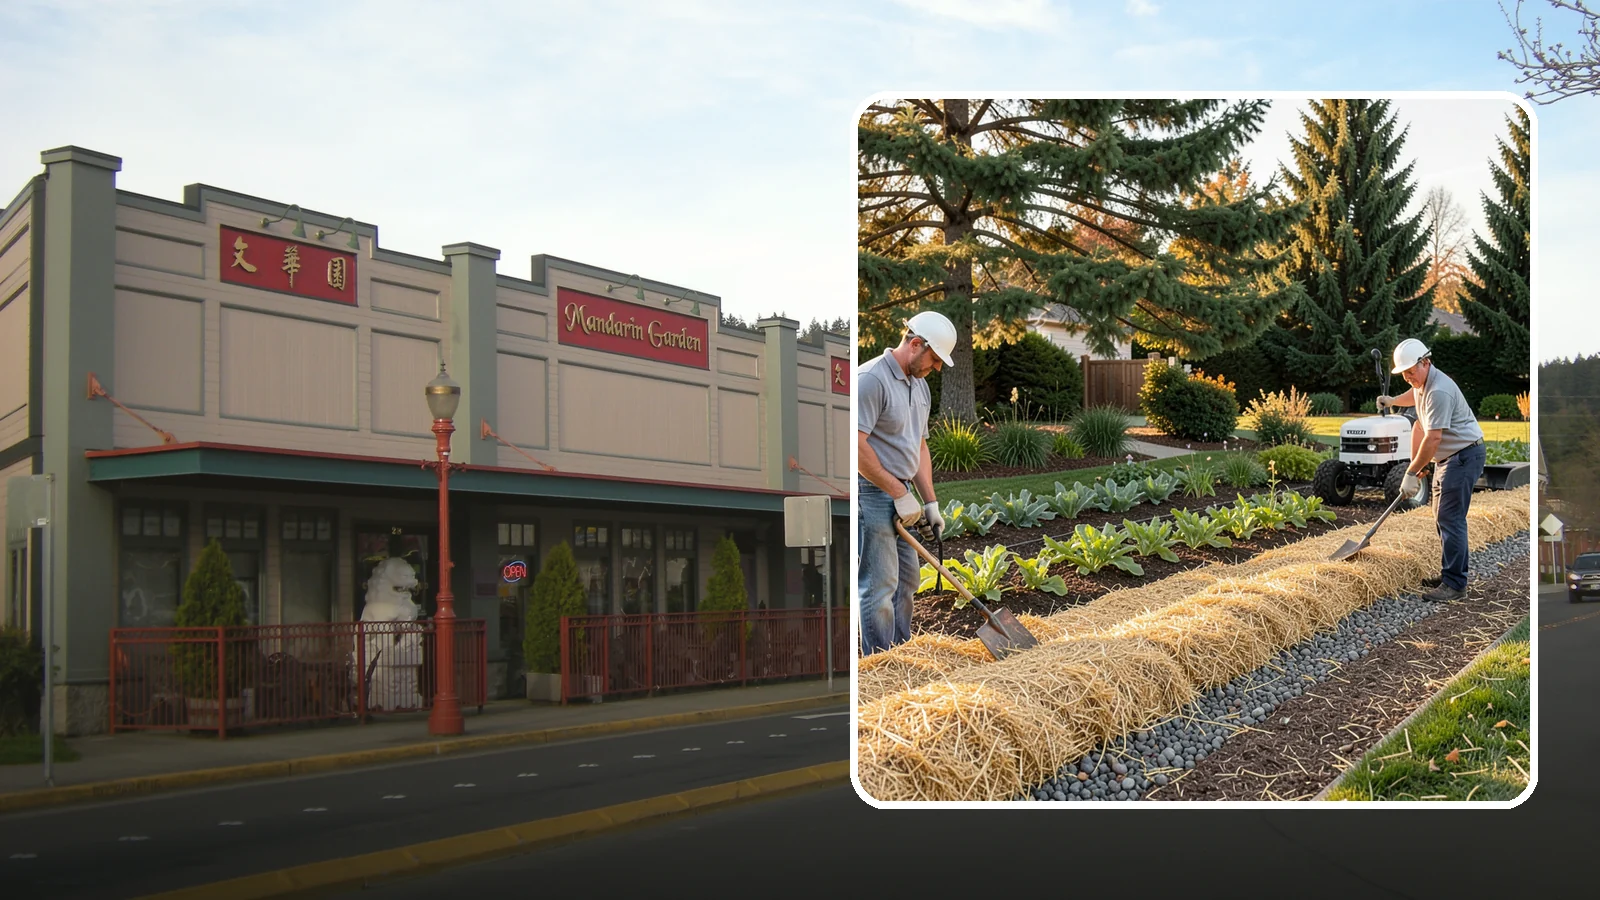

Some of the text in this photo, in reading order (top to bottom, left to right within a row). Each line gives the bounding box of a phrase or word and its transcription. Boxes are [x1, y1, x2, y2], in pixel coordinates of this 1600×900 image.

[230, 235, 347, 291] 文華園
[565, 302, 701, 352] Mandarin Garden
[503, 565, 527, 578] OPEN
